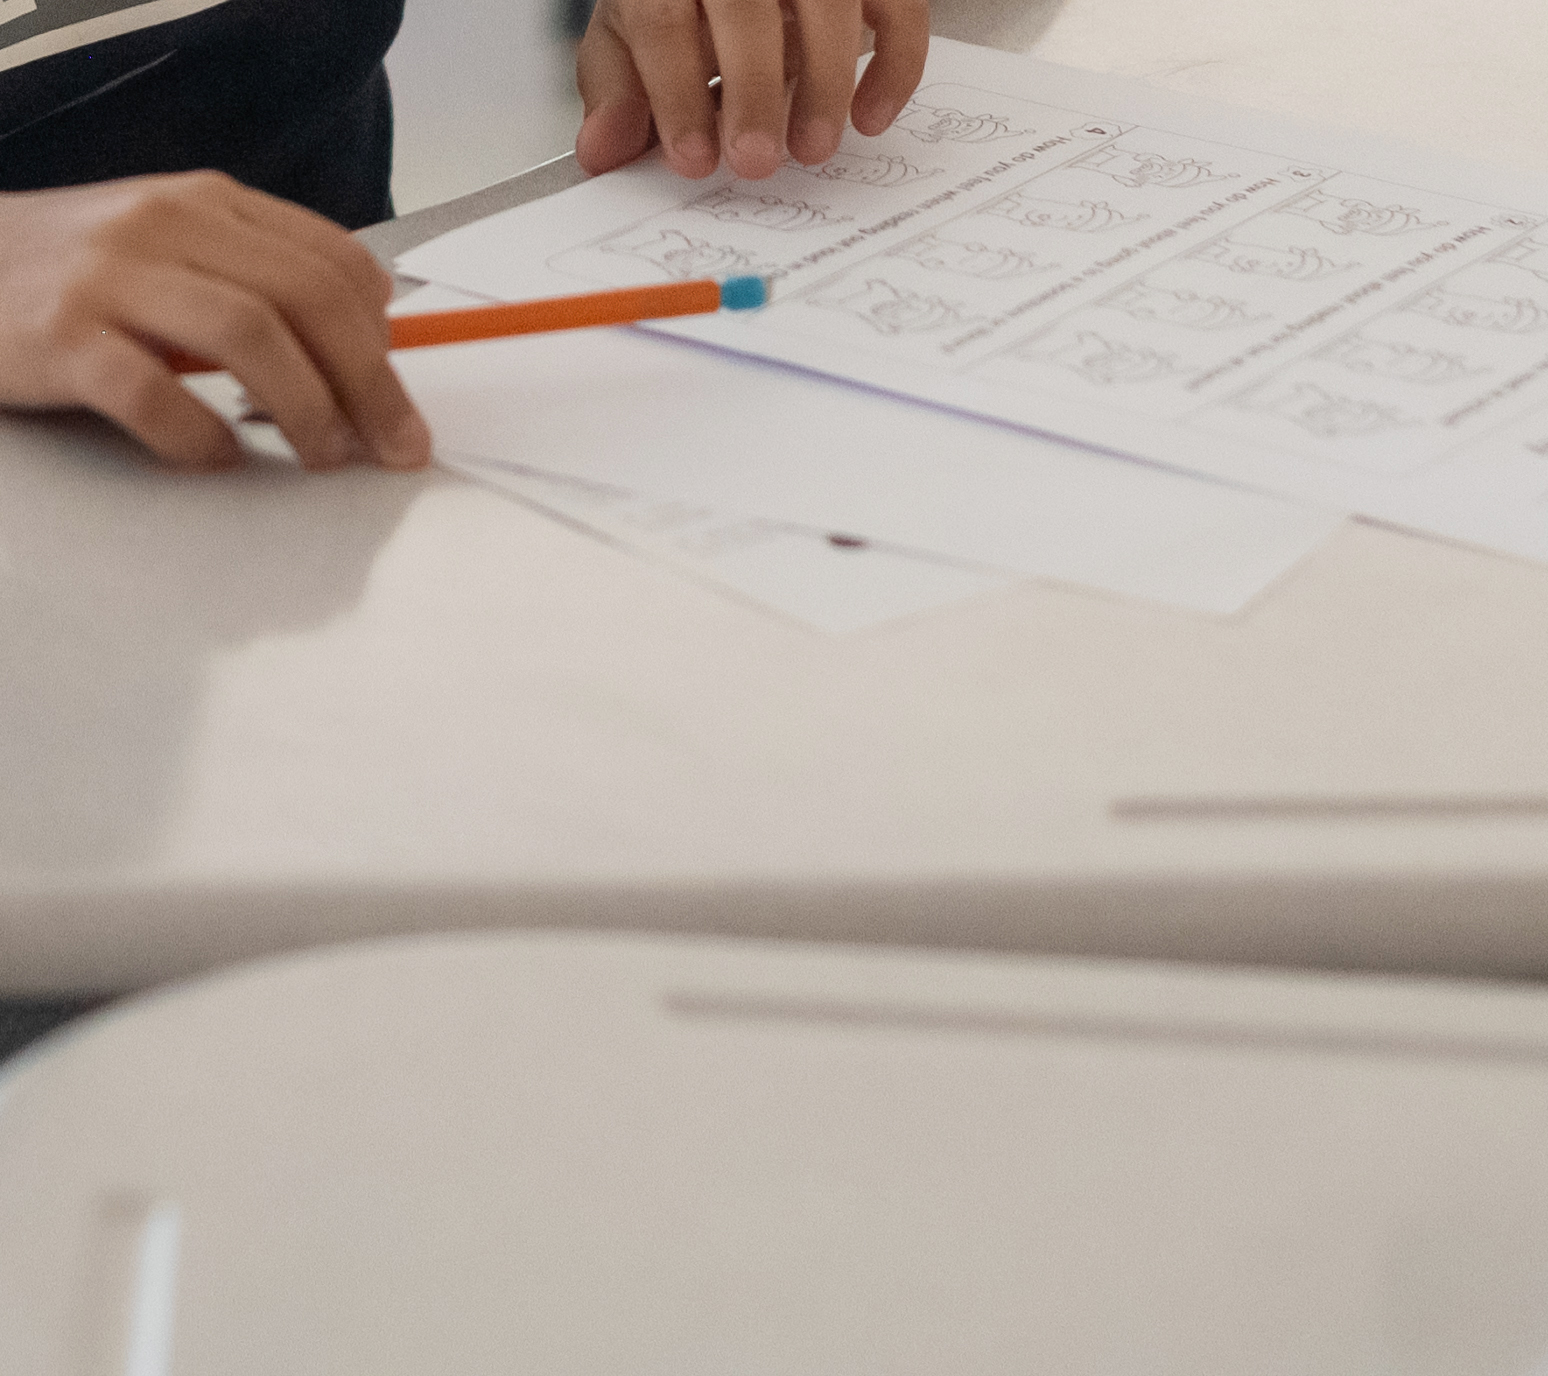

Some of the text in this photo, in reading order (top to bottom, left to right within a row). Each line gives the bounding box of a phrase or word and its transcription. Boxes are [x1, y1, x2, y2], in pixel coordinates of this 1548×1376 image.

[1085, 126, 1107, 136] 4
[1032, 136, 1070, 153] How
[1011, 152, 1036, 163] do
[984, 160, 1014, 177] you
[957, 175, 992, 192] feel
[1244, 177, 1278, 194] How
[919, 189, 958, 210] when
[1225, 192, 1248, 203] do
[1199, 200, 1227, 217] you
[858, 209, 919, 236] reading
[1175, 215, 1207, 230] feel
[1453, 225, 1490, 244] How
[1433, 242, 1458, 254] do
[1407, 251, 1435, 268] you
